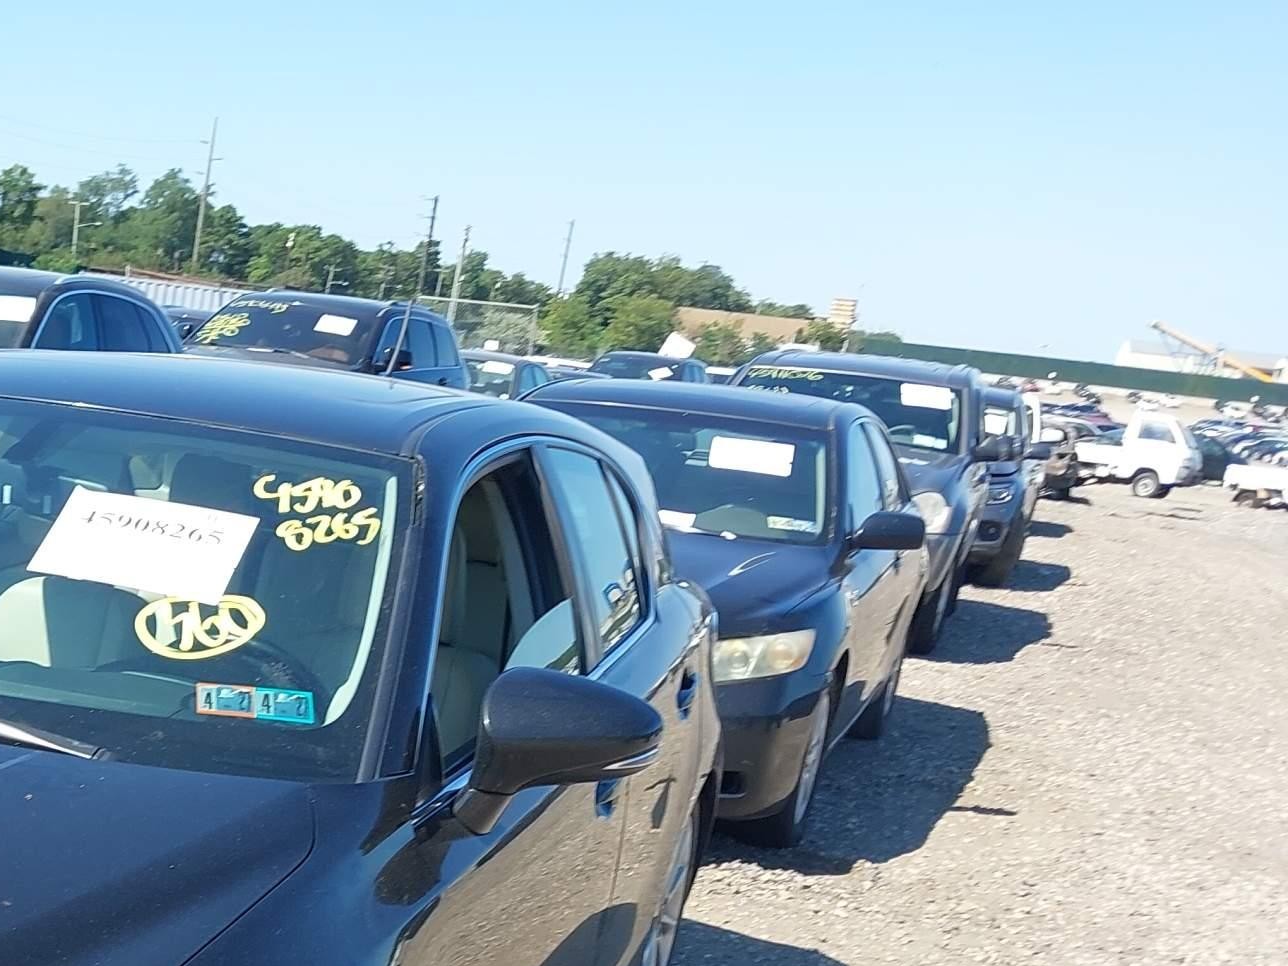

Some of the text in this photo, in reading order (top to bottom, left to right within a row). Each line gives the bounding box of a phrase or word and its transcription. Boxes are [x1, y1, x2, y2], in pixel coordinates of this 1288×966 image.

[80, 510, 225, 545] 45908265
[275, 507, 381, 551] 8265
[204, 692, 213, 710] 4
[261, 693, 272, 714] 4
